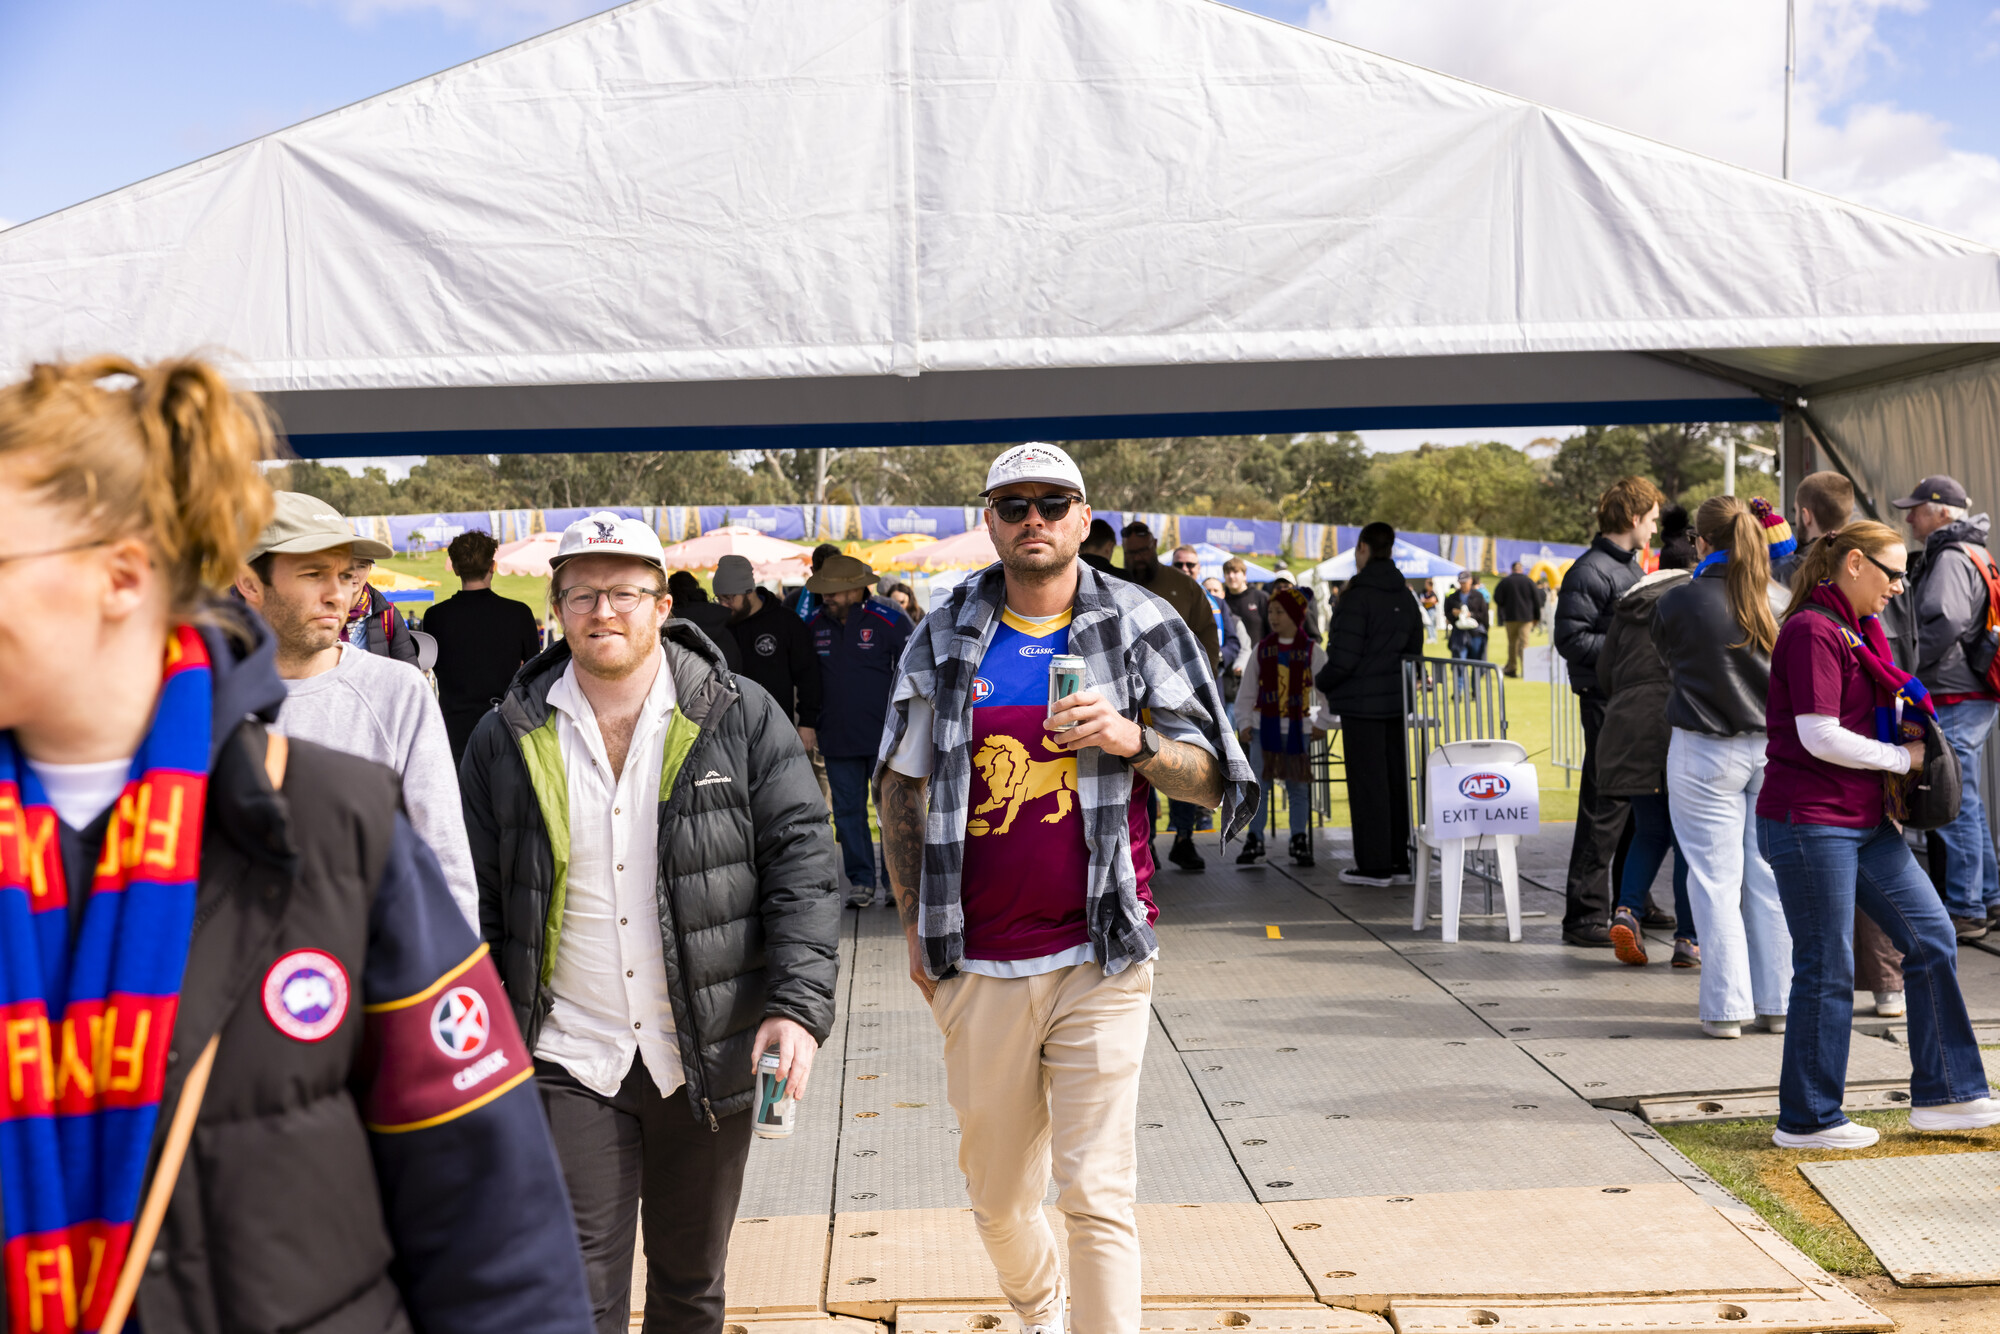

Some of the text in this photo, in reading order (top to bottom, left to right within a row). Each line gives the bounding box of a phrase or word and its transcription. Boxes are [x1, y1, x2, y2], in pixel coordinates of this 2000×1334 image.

[1025, 647, 1055, 655] CLASSIC
[1463, 778, 1508, 795] AFL
[1442, 806, 1529, 823] EXIT LANE
